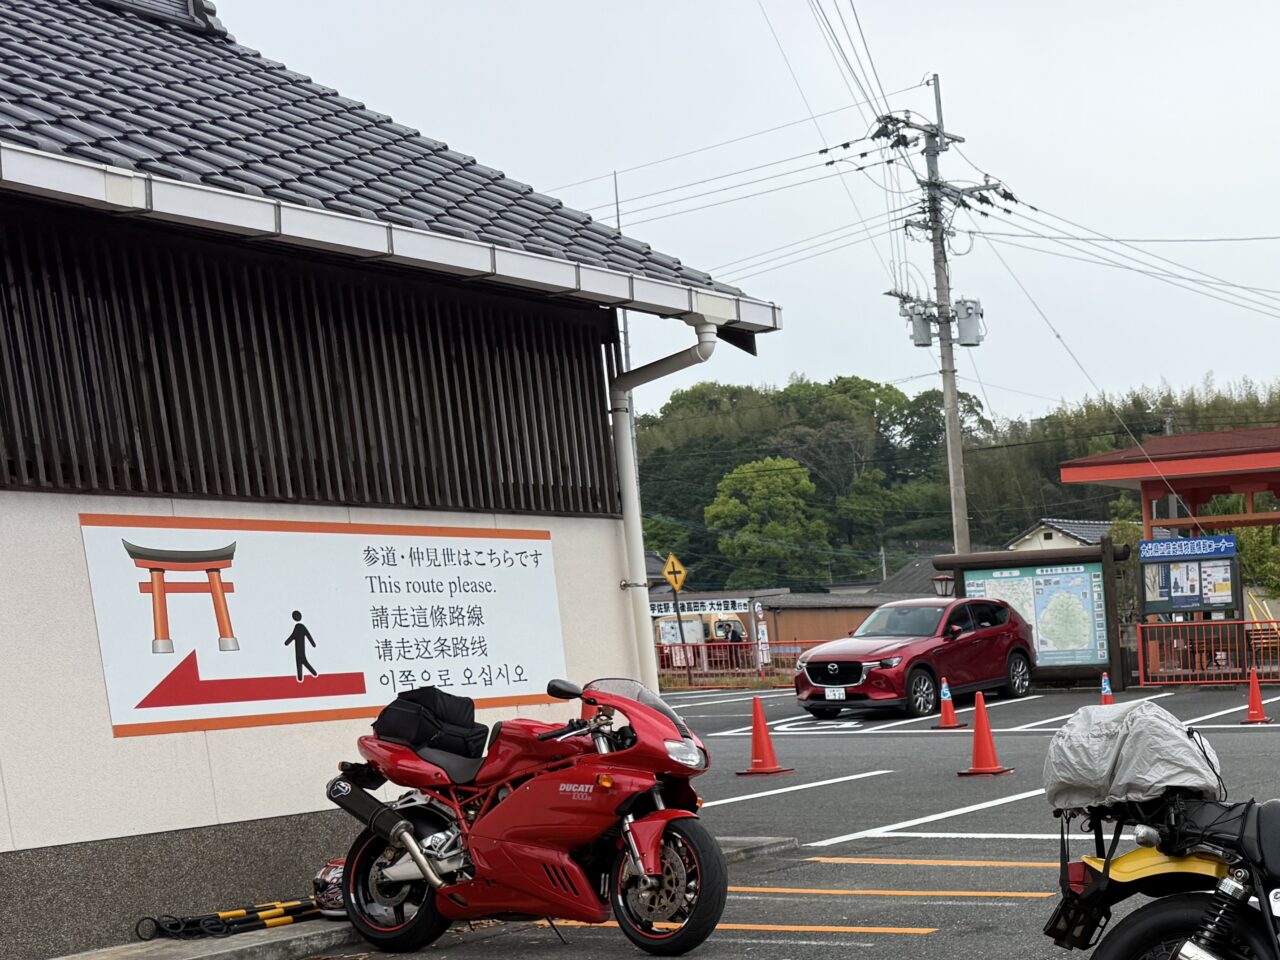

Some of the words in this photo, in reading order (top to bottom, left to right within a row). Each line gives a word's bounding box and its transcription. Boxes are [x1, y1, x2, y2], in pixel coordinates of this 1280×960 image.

[363, 546, 542, 568] 参道・仲見世はこちらです
[365, 576, 400, 594] This
[405, 580, 444, 594] route
[449, 576, 497, 598] please.
[370, 605, 485, 629] 請走這條路線
[375, 636, 488, 661] 请走这条路线
[380, 669, 454, 693] 이쪽으로
[461, 664, 528, 686] 오십시오
[559, 783, 594, 792] DUCATI
